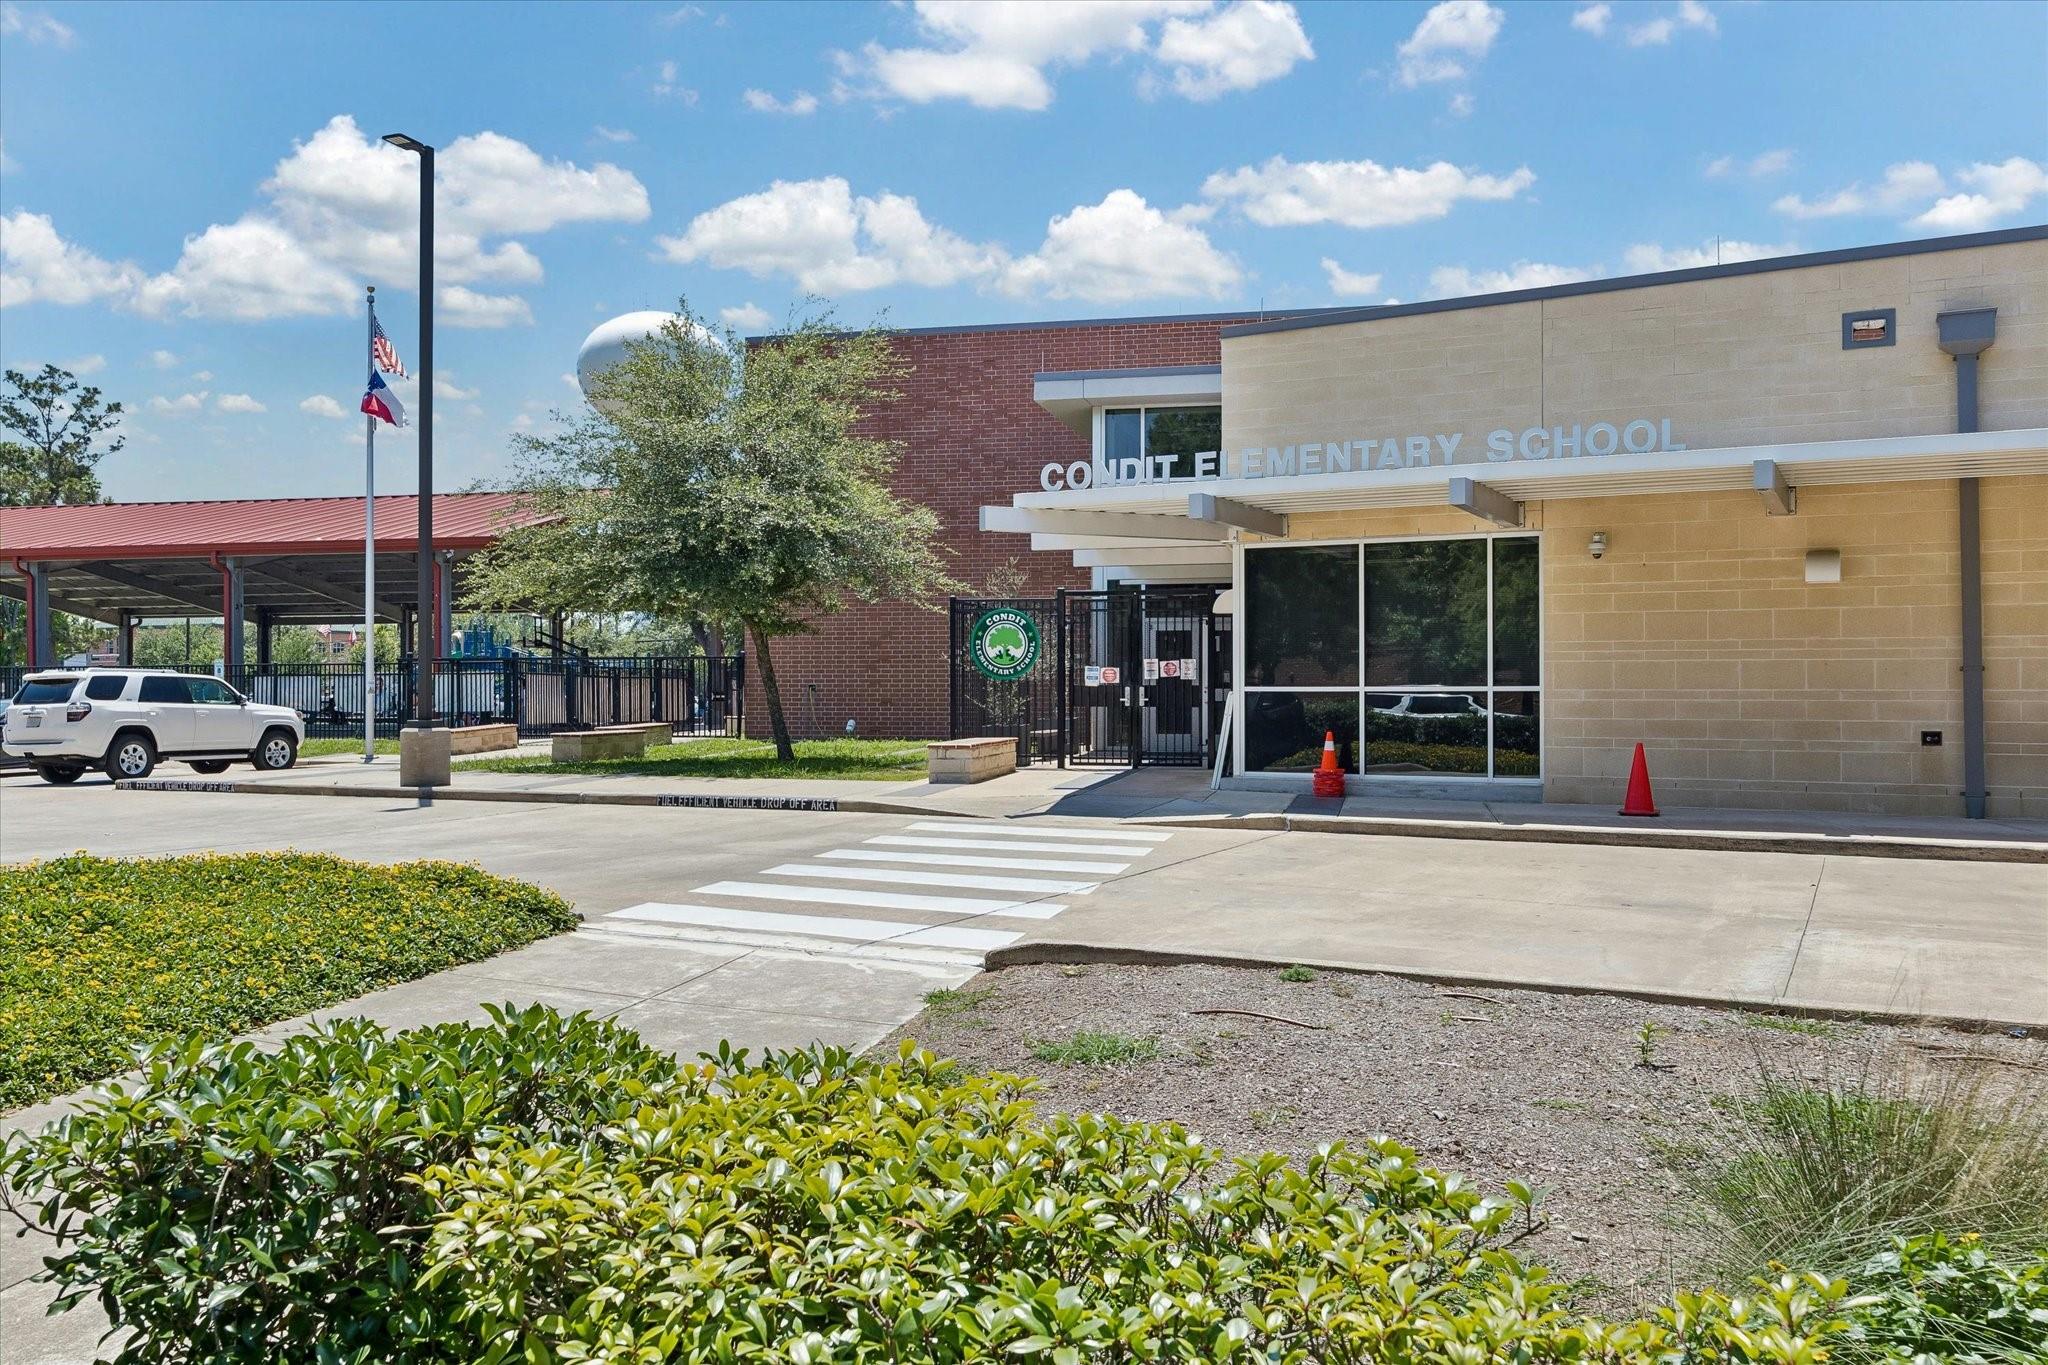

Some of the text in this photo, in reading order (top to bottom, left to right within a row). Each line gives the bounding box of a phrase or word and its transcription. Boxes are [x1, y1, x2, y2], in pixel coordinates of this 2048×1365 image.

[1040, 417, 1688, 492] CONDIT ELEMENTARY SCHOOL
[985, 613, 1027, 626] CONDIT
[975, 640, 1036, 675] ELEMENTARY SCHOOL
[656, 795, 677, 806] FUEL
[760, 797, 786, 809] DROP
[789, 798, 807, 810] OFF
[811, 799, 836, 811] AREA
